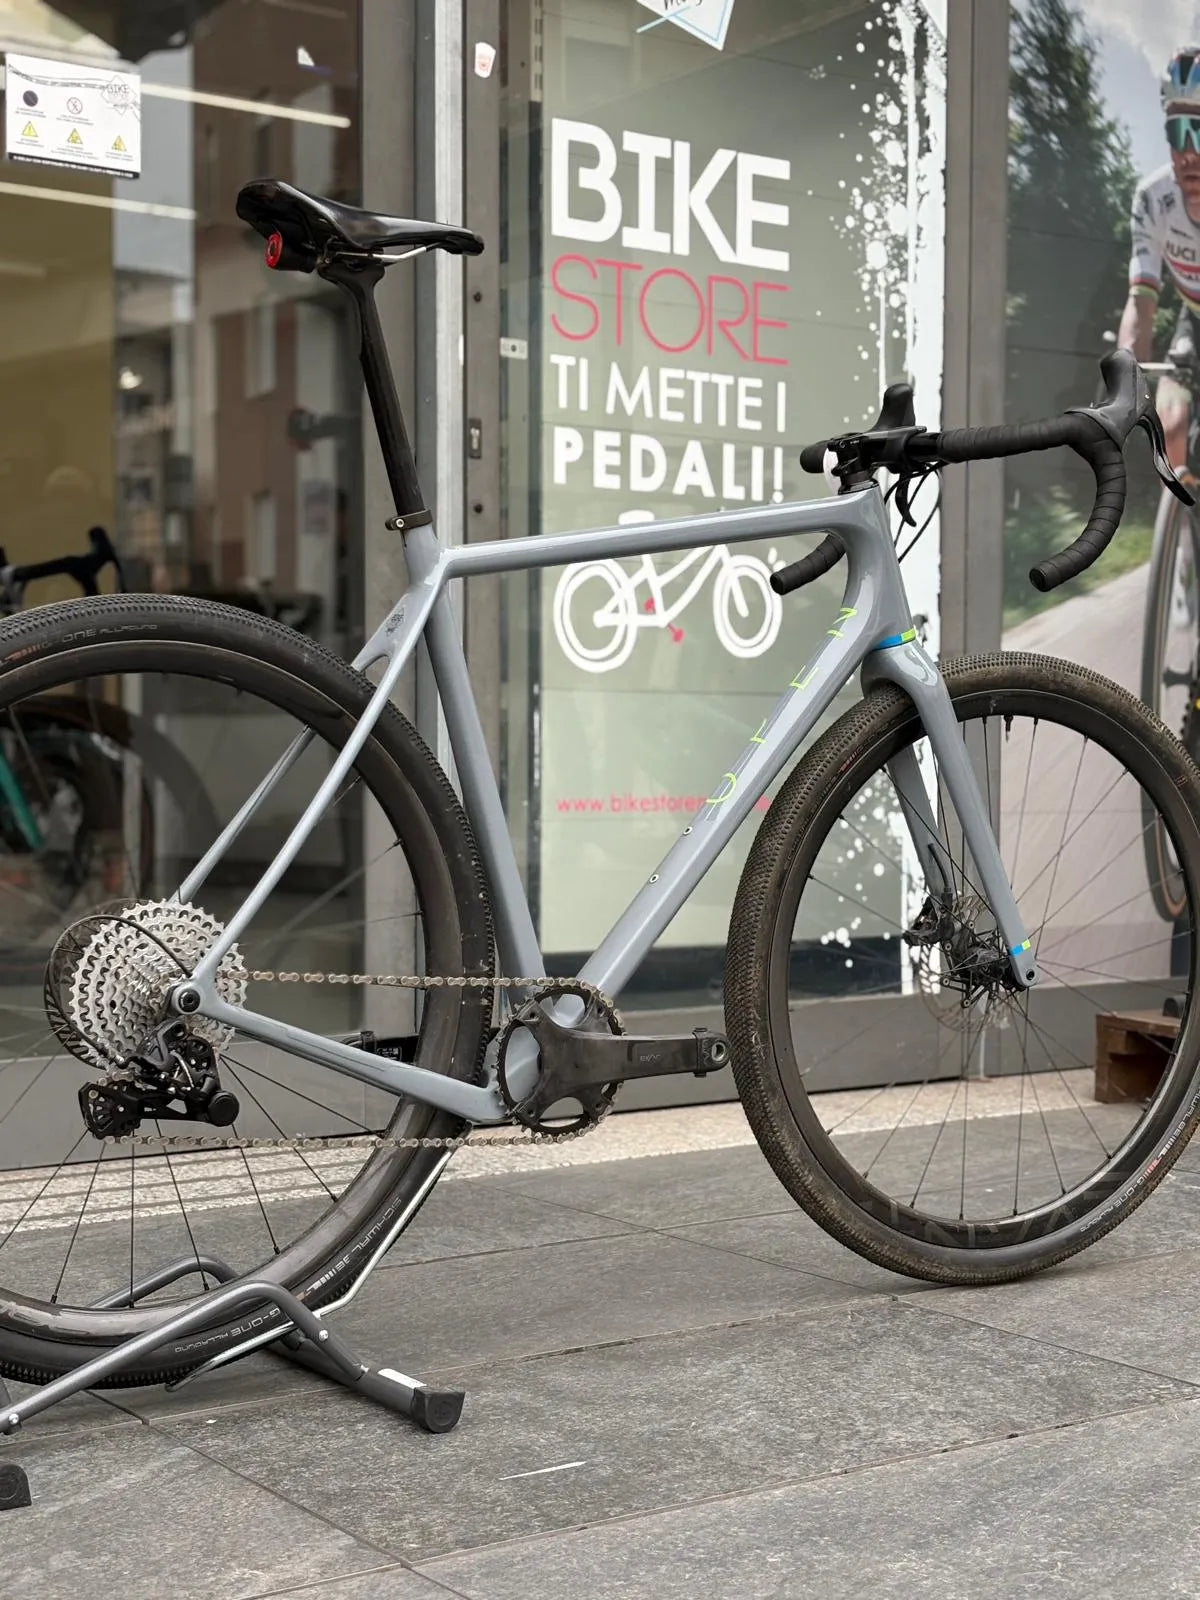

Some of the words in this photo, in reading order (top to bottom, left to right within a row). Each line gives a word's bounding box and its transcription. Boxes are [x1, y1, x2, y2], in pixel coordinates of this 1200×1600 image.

[551, 117, 791, 272] BIKE
[551, 252, 790, 366] STORE
[550, 353, 589, 412] TI
[605, 361, 763, 431] METTE
[553, 425, 784, 504] PEDALI!
[230, 1306, 281, 1338] G-ONE
